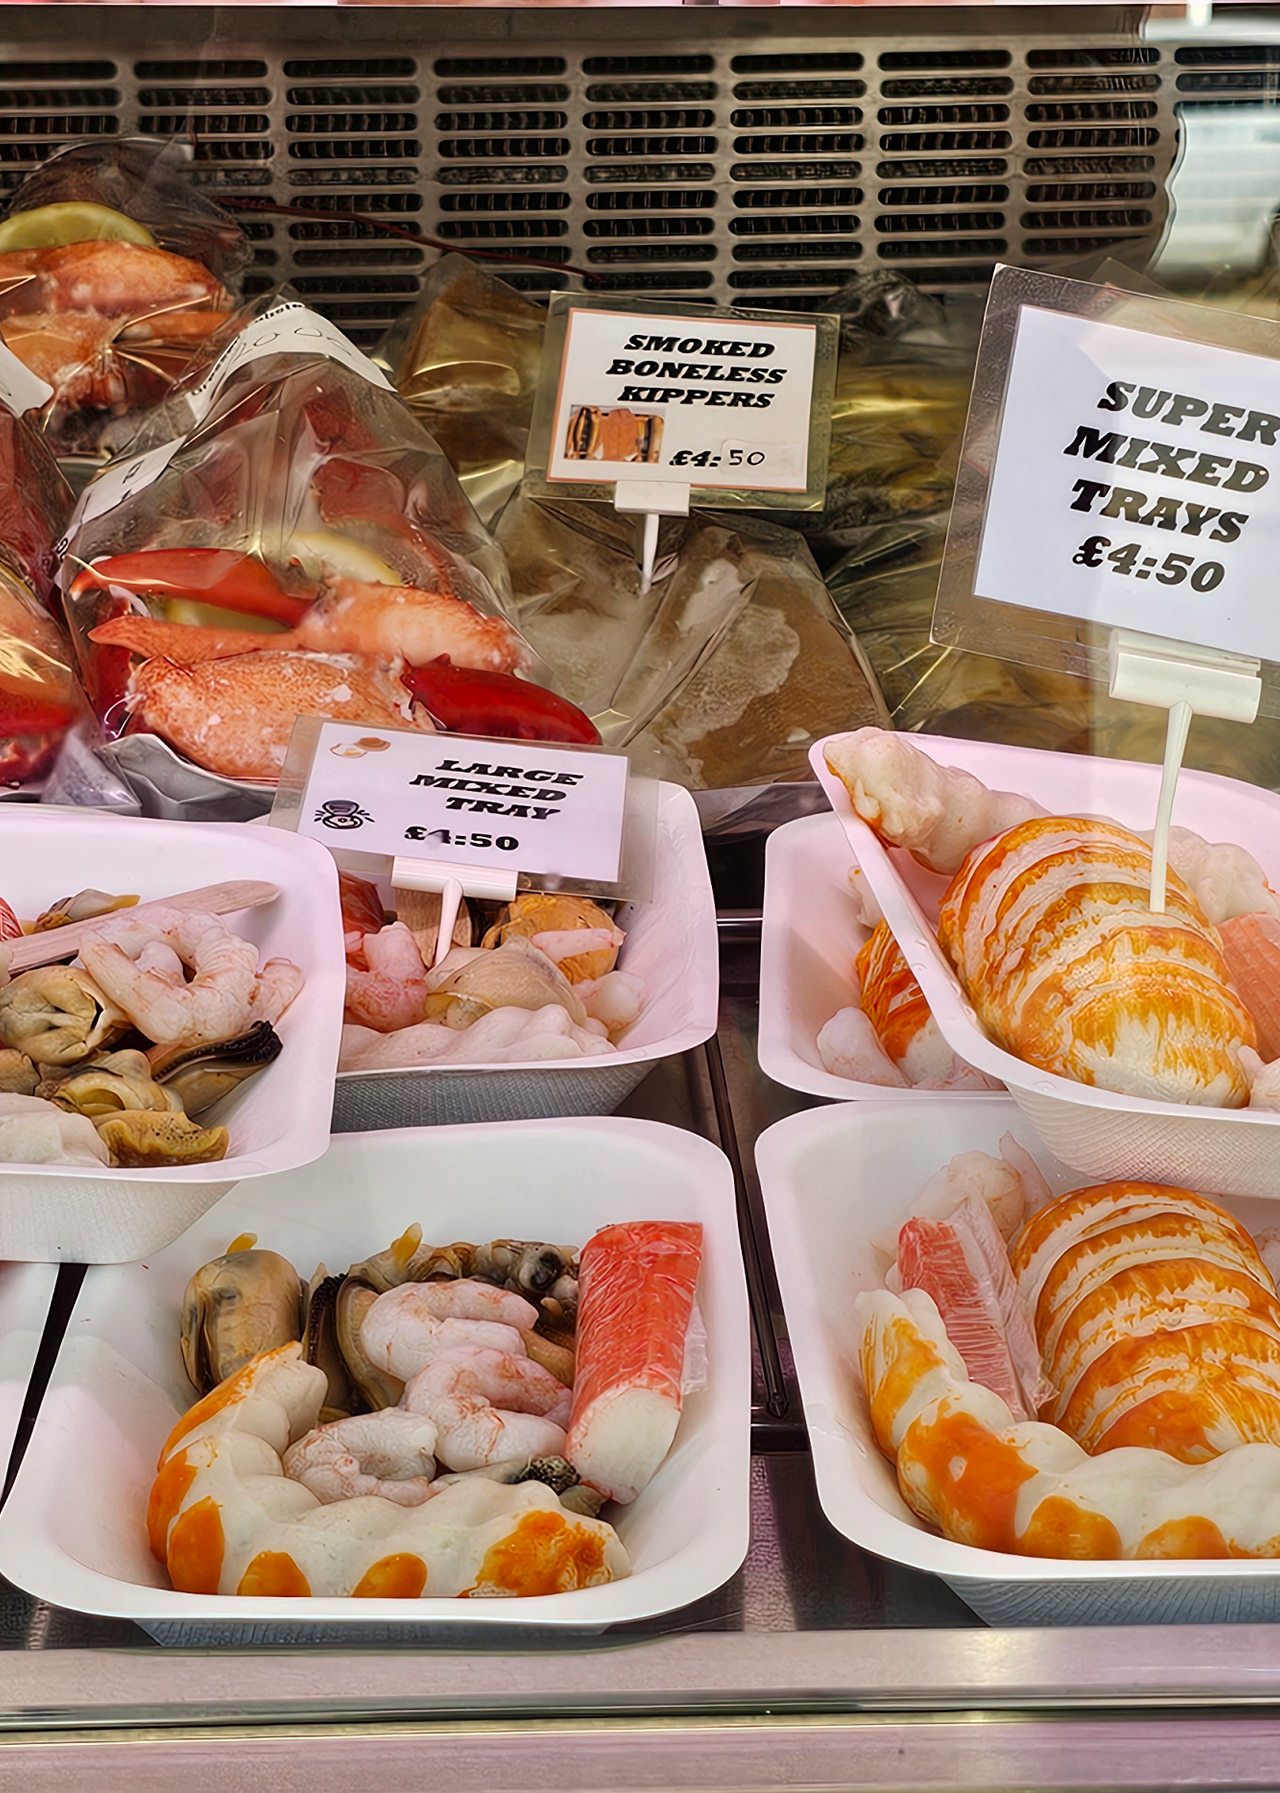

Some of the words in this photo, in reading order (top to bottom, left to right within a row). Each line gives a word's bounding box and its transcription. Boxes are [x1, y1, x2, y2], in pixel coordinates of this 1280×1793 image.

[623, 334, 776, 358] SMOKED
[605, 359, 788, 384] BONELESS
[617, 386, 776, 408] KIPPERS
[1063, 425, 1270, 493] MIXED
[1069, 478, 1250, 543] TRAYS
[1072, 535, 1226, 592] £4:50
[435, 759, 584, 785] LARGE
[408, 774, 567, 801] MIXED
[445, 797, 561, 820] TRAY
[404, 825, 520, 851] £4:50
